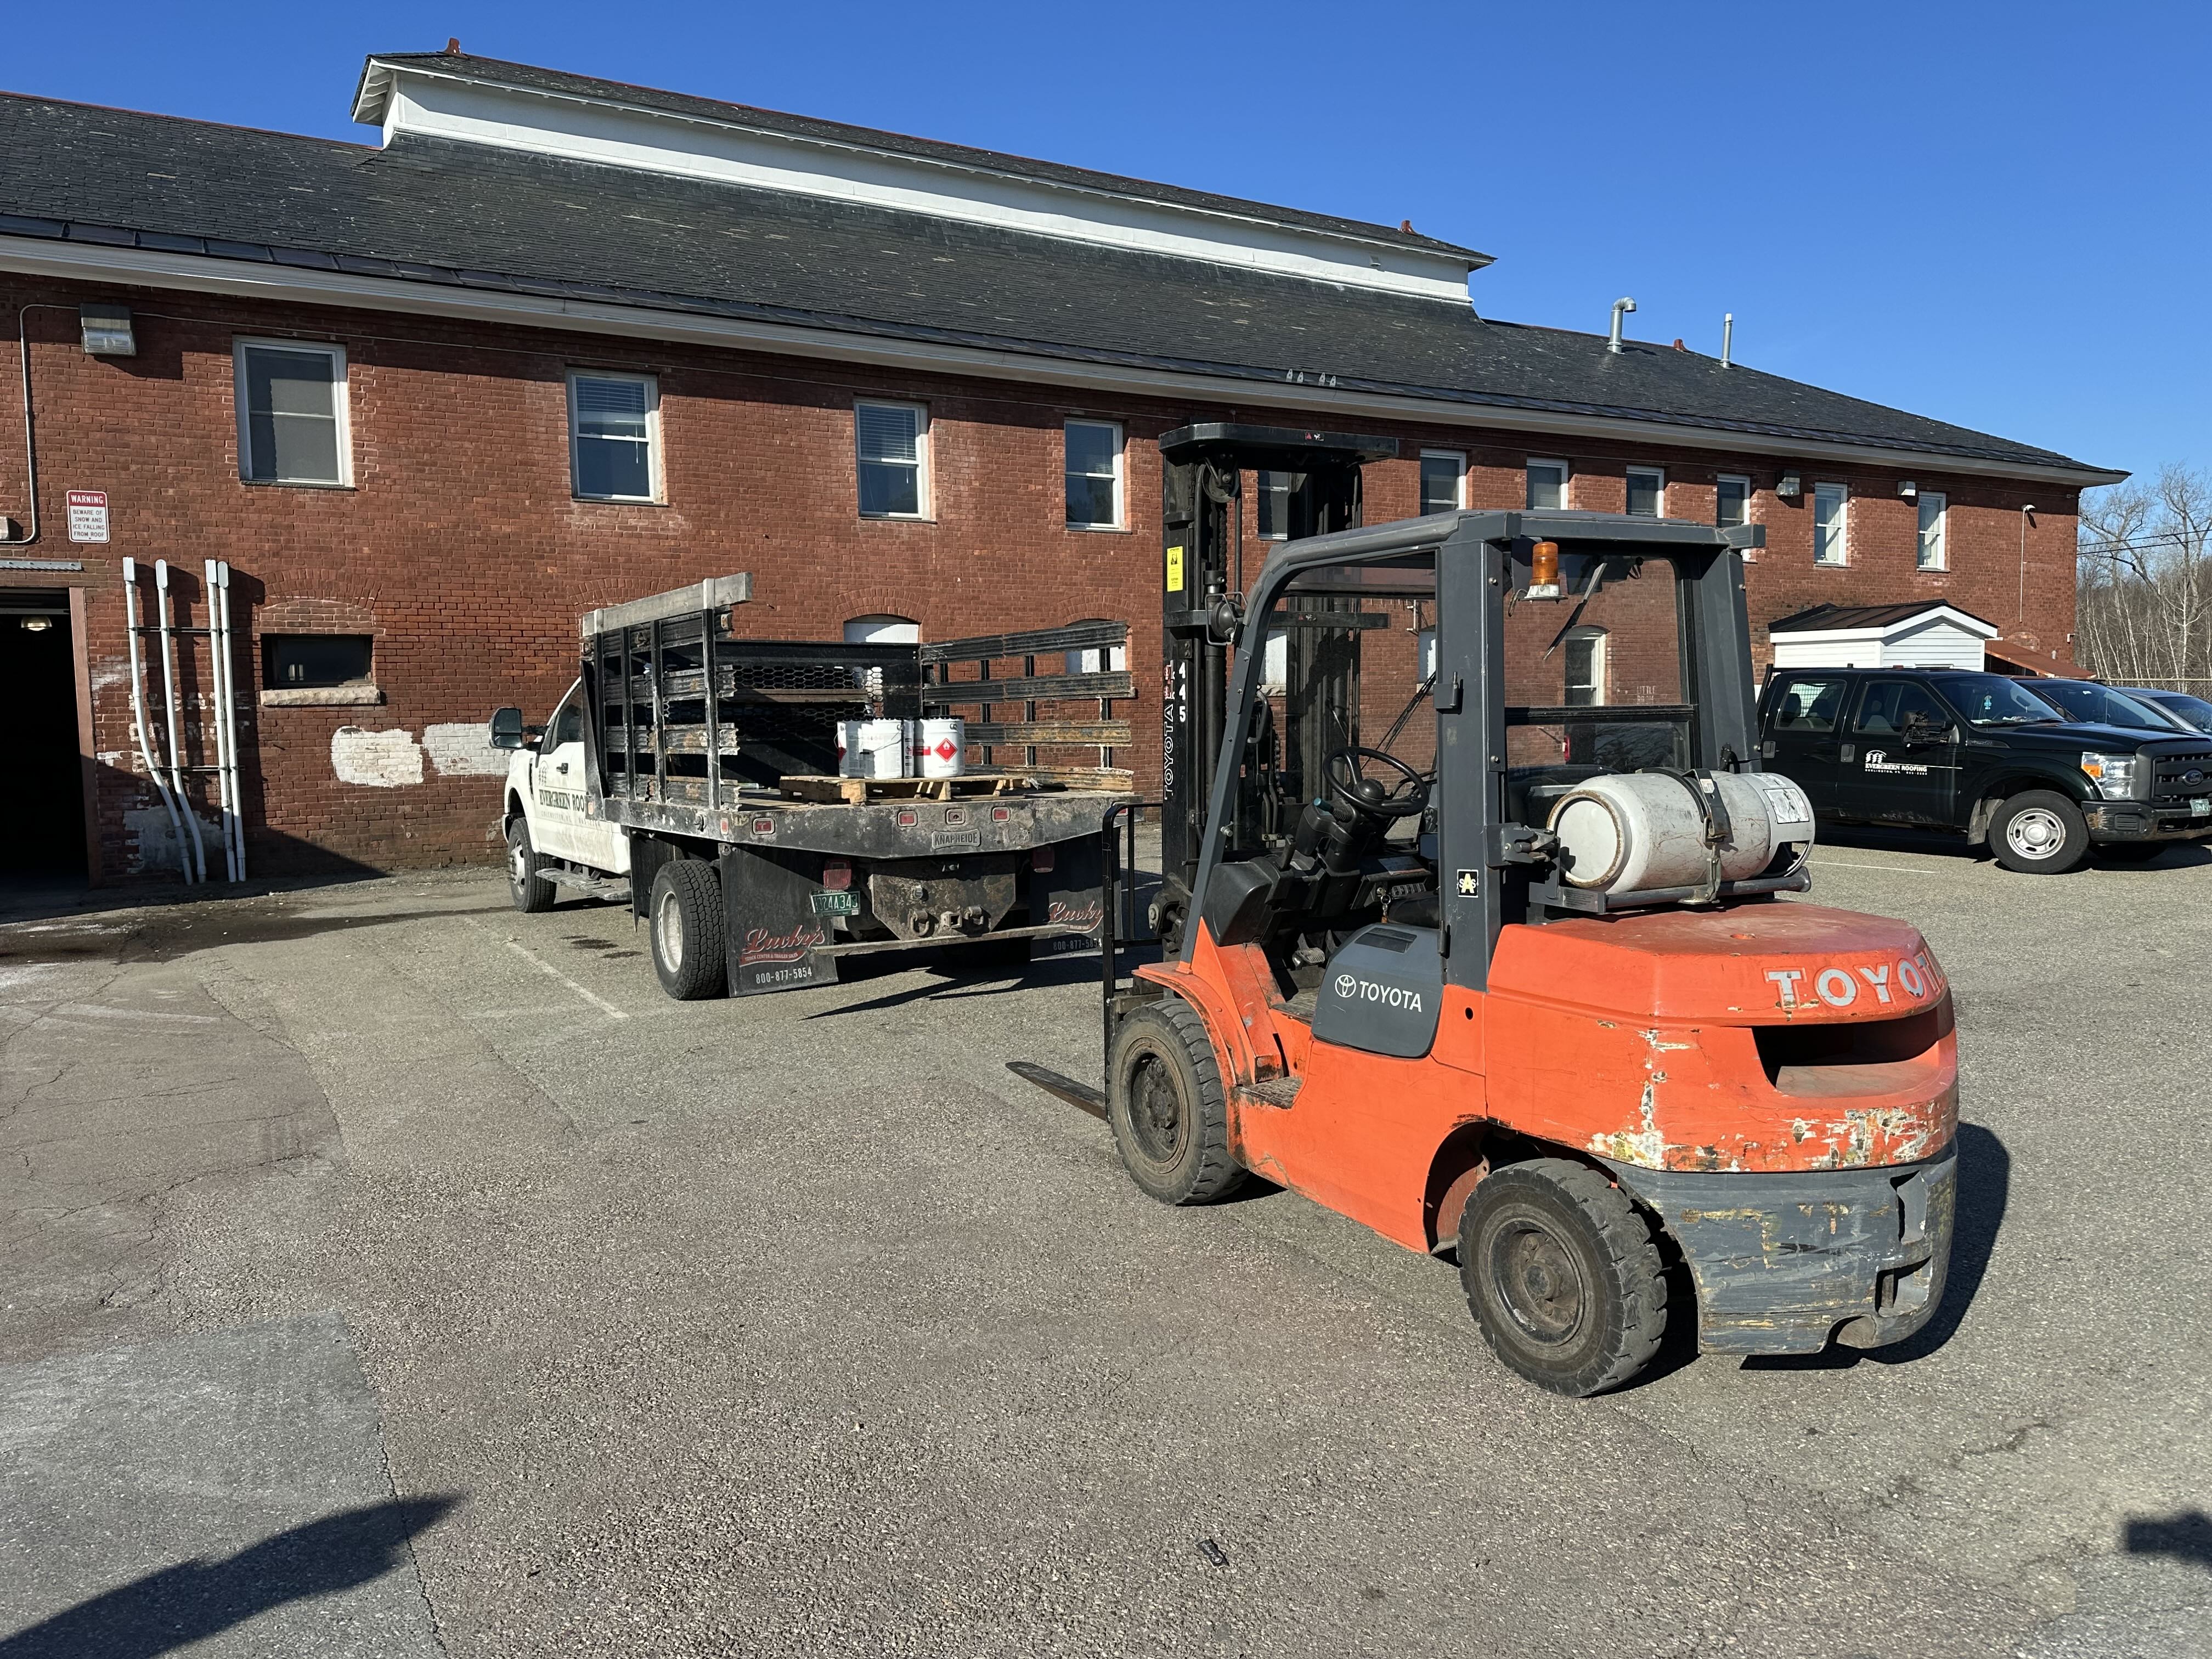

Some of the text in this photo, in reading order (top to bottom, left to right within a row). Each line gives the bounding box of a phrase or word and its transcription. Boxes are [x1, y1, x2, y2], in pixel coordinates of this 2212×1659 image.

[71, 494, 103, 504] WARNING
[1164, 703, 1173, 800] TOYOTA
[539, 789, 585, 812] EVERGREEN ROO
[935, 832, 978, 845] KNAPHEIDE
[1048, 900, 1103, 923] Lucky
[742, 924, 825, 954] Lucky's
[1053, 938, 1102, 951] 800-877-5854
[755, 967, 812, 984] 800-877-5854
[1359, 980, 1422, 1013] TOYOTA
